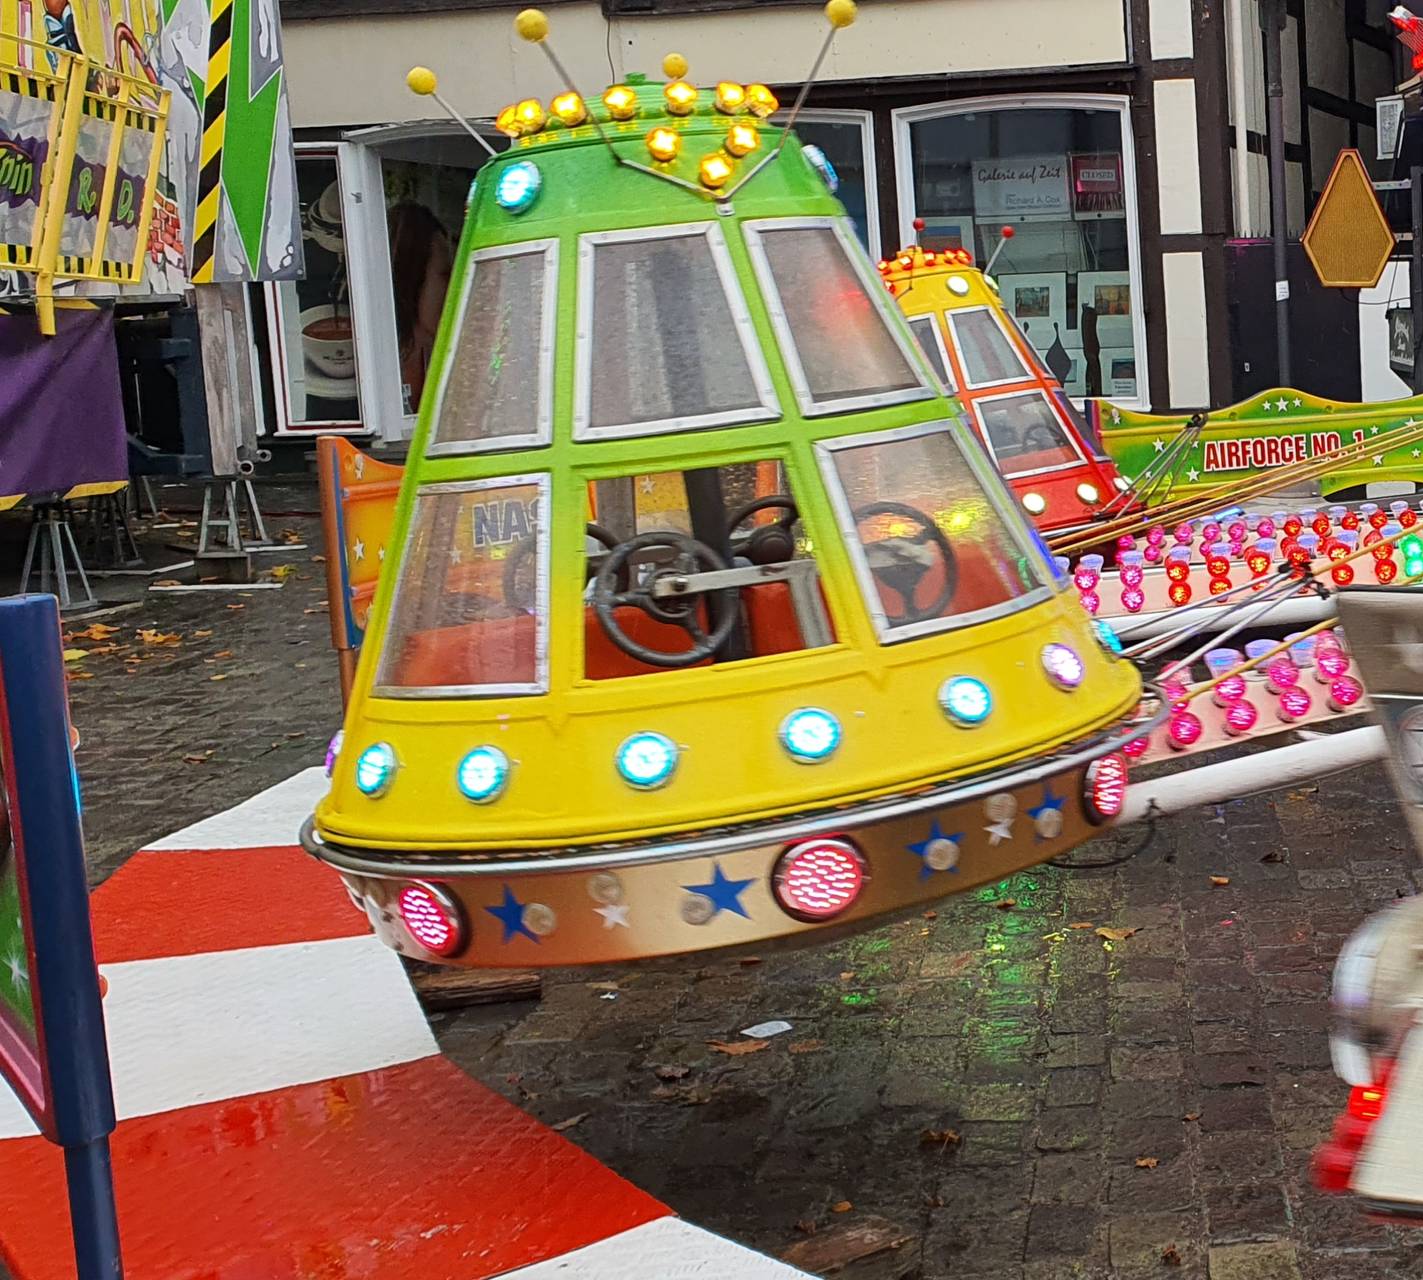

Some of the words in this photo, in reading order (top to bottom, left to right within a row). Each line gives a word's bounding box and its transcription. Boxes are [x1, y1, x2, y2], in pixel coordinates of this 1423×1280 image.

[977, 167, 1016, 183] Galerie
[1018, 165, 1037, 184] auf
[1039, 164, 1062, 179] Zeit
[1204, 434, 1306, 472] AIRFORCE
[1353, 429, 1366, 460] 1
